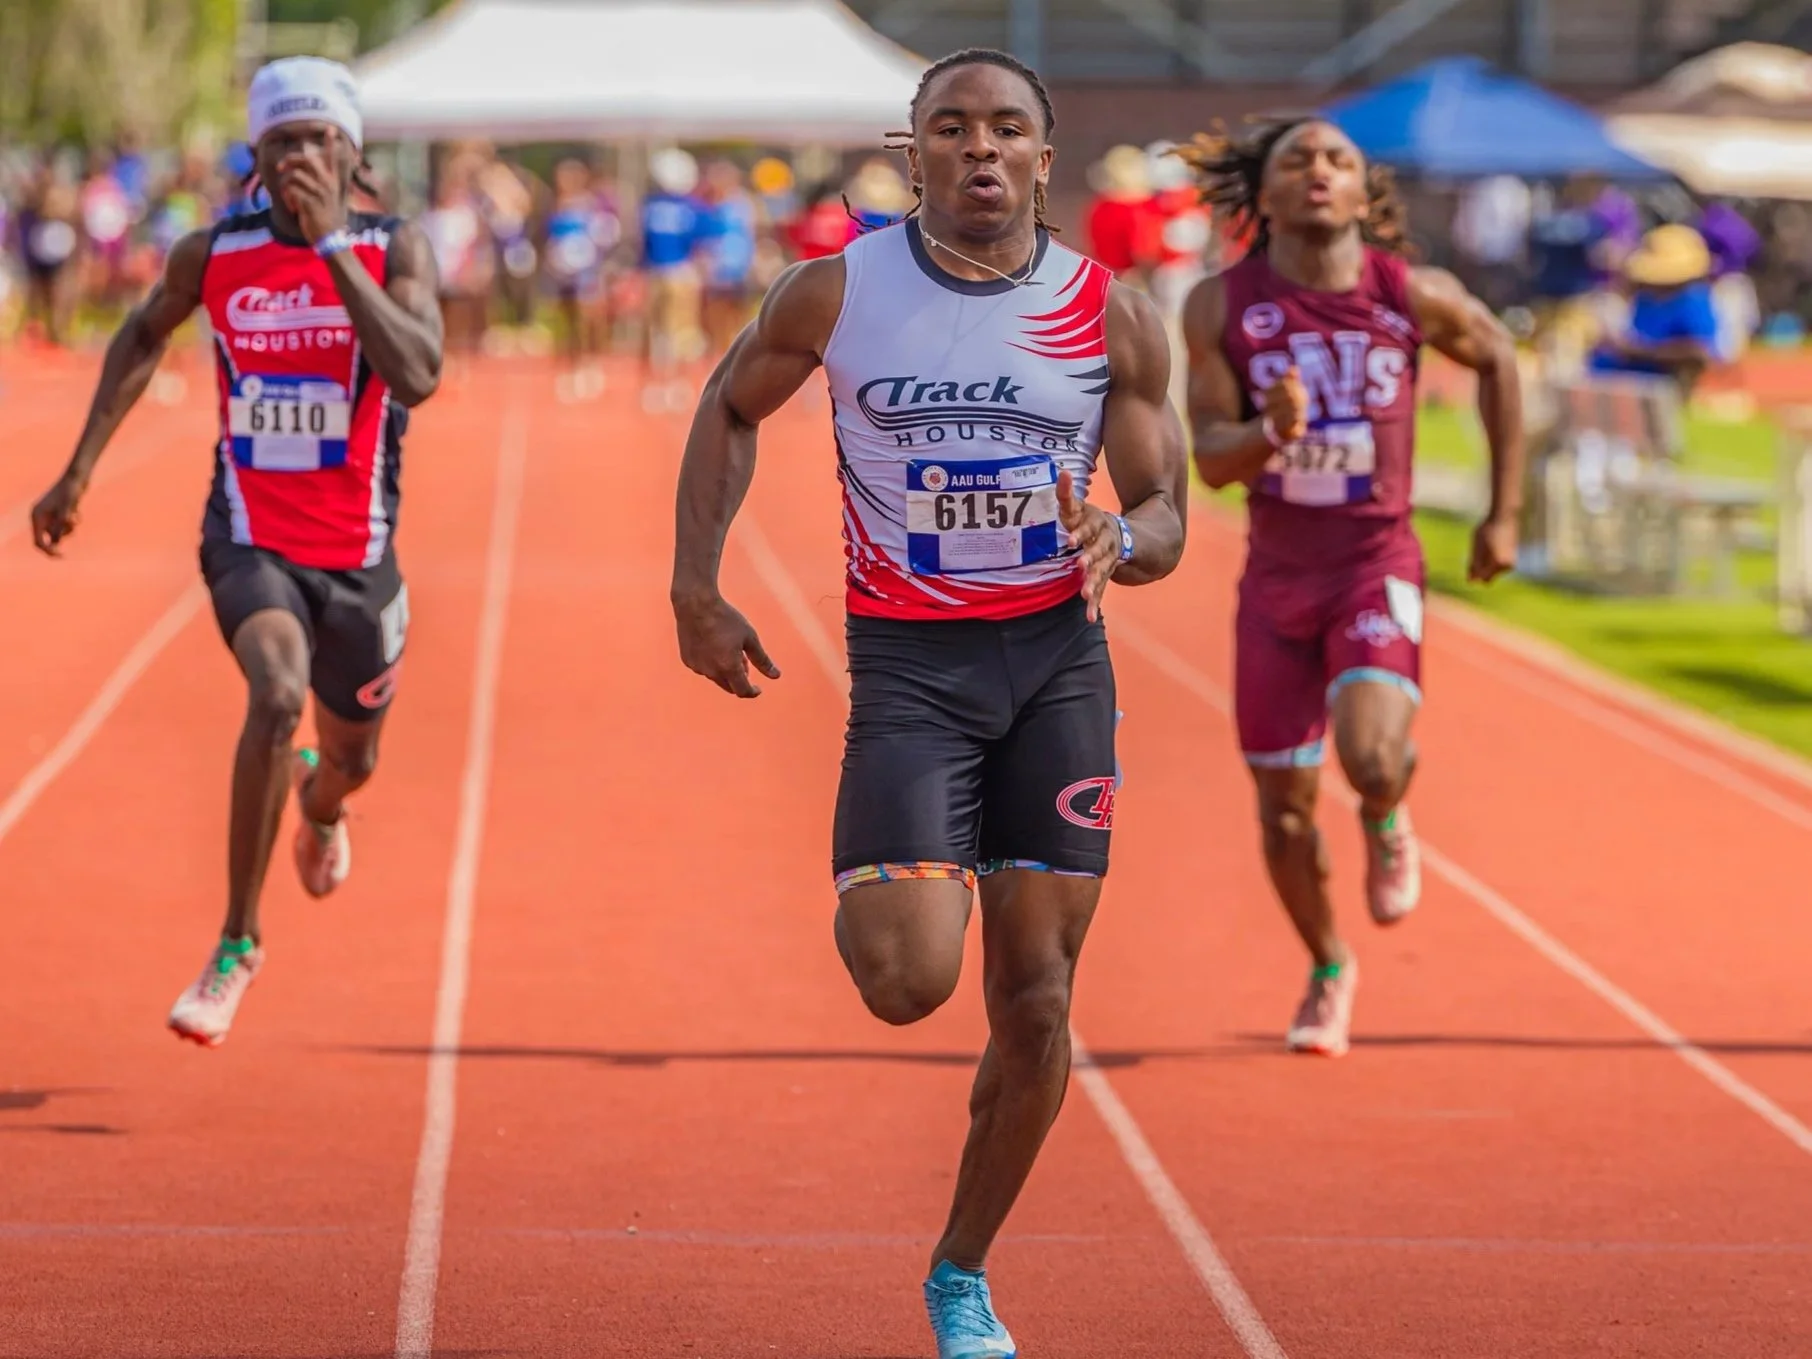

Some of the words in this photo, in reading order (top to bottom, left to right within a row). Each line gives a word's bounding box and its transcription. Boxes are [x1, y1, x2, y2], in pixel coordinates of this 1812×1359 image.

[227, 283, 314, 312] Track
[233, 329, 352, 352] HOUSTON
[857, 375, 1025, 408] Track
[250, 401, 325, 433] 6110
[894, 423, 1079, 452] HOUSTON
[951, 474, 973, 487] AAU
[934, 490, 1033, 532] 6157
